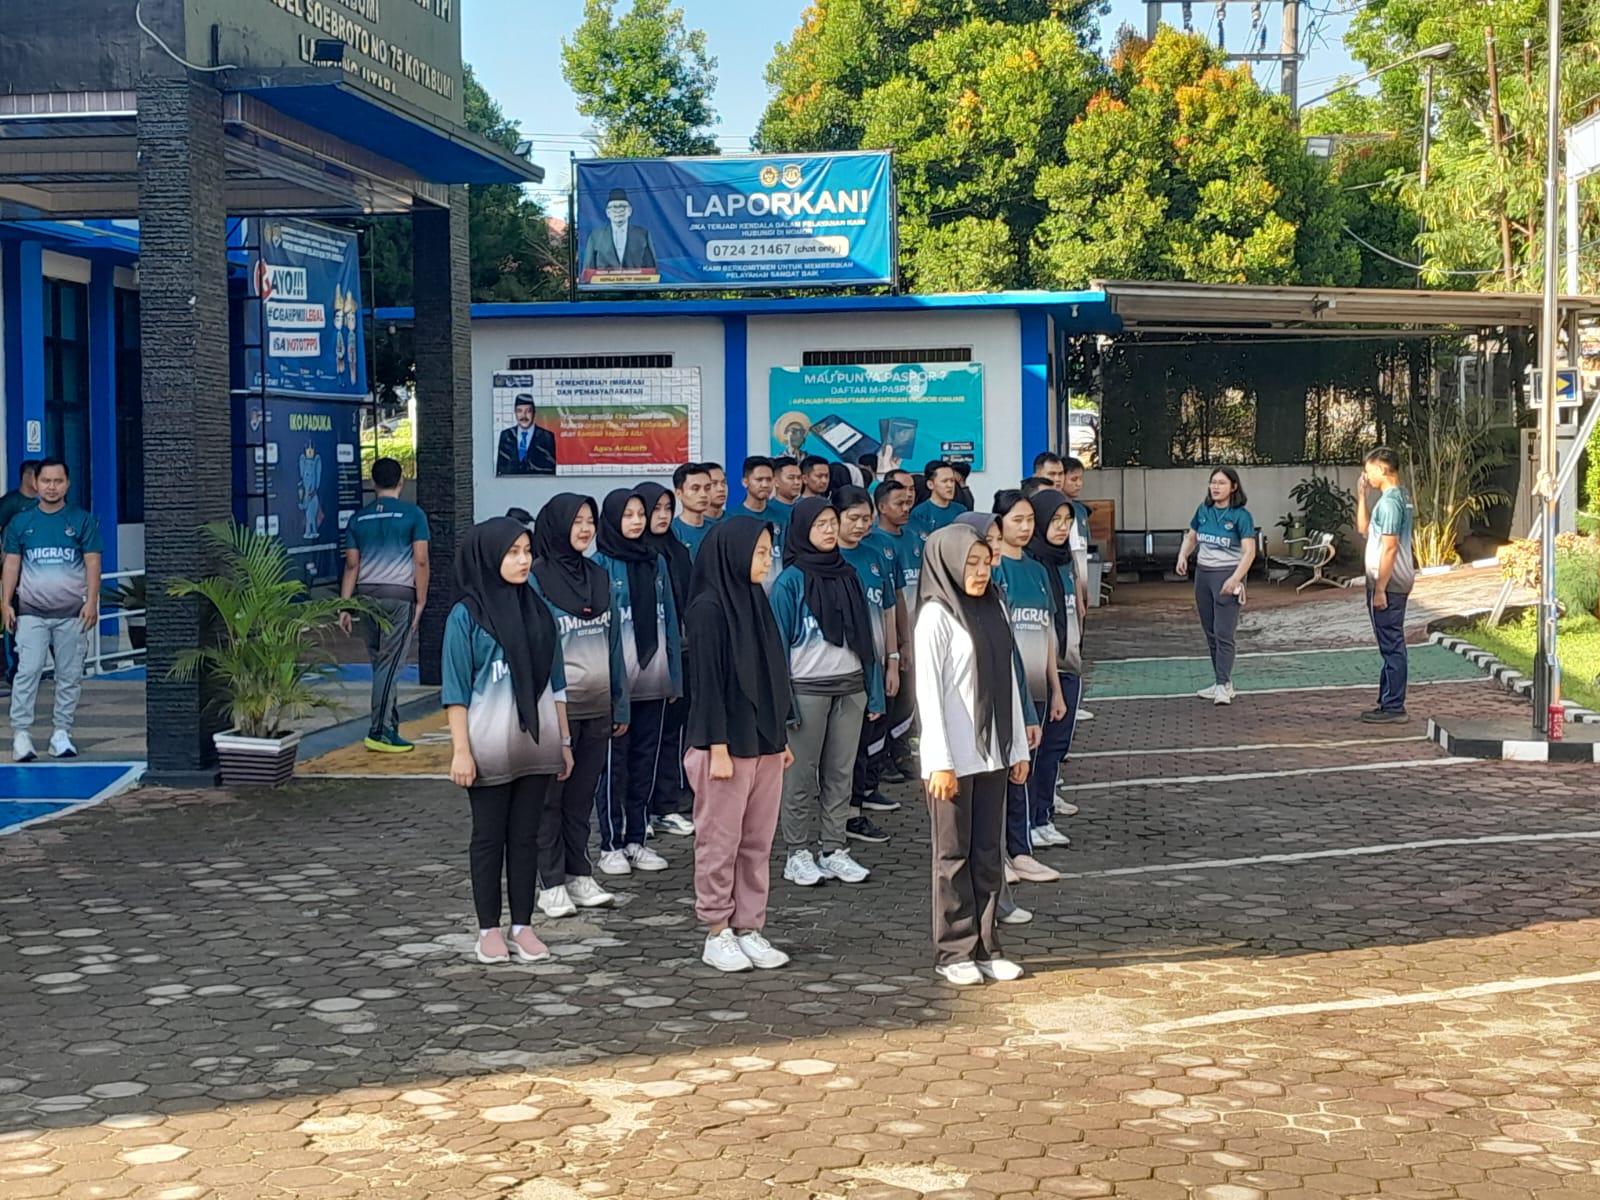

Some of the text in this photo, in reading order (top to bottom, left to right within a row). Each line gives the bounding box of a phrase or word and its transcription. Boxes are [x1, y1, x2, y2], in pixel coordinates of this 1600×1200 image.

[305, 0, 369, 54] SOEBROTO
[371, 34, 387, 64] NO
[390, 45, 403, 72] 75
[405, 53, 454, 100] KOTABUMI
[686, 190, 869, 218] LAPORKAN!
[707, 222, 738, 230] TERJADI
[739, 221, 773, 230] KENDALA
[775, 221, 800, 229] DALAM
[742, 229, 775, 237] HUBUNGI
[713, 245, 746, 257] 0724
[751, 243, 791, 256] 21467
[722, 264, 776, 272] BERKOMITMEN
[804, 262, 854, 270] MEMBERIKAN
[272, 270, 304, 296] AYO!!!
[804, 373, 834, 384] MAU
[837, 371, 884, 384] PUNYA
[885, 371, 937, 382] PASPOR
[831, 385, 920, 395] DAFTAR M-PASPOR
